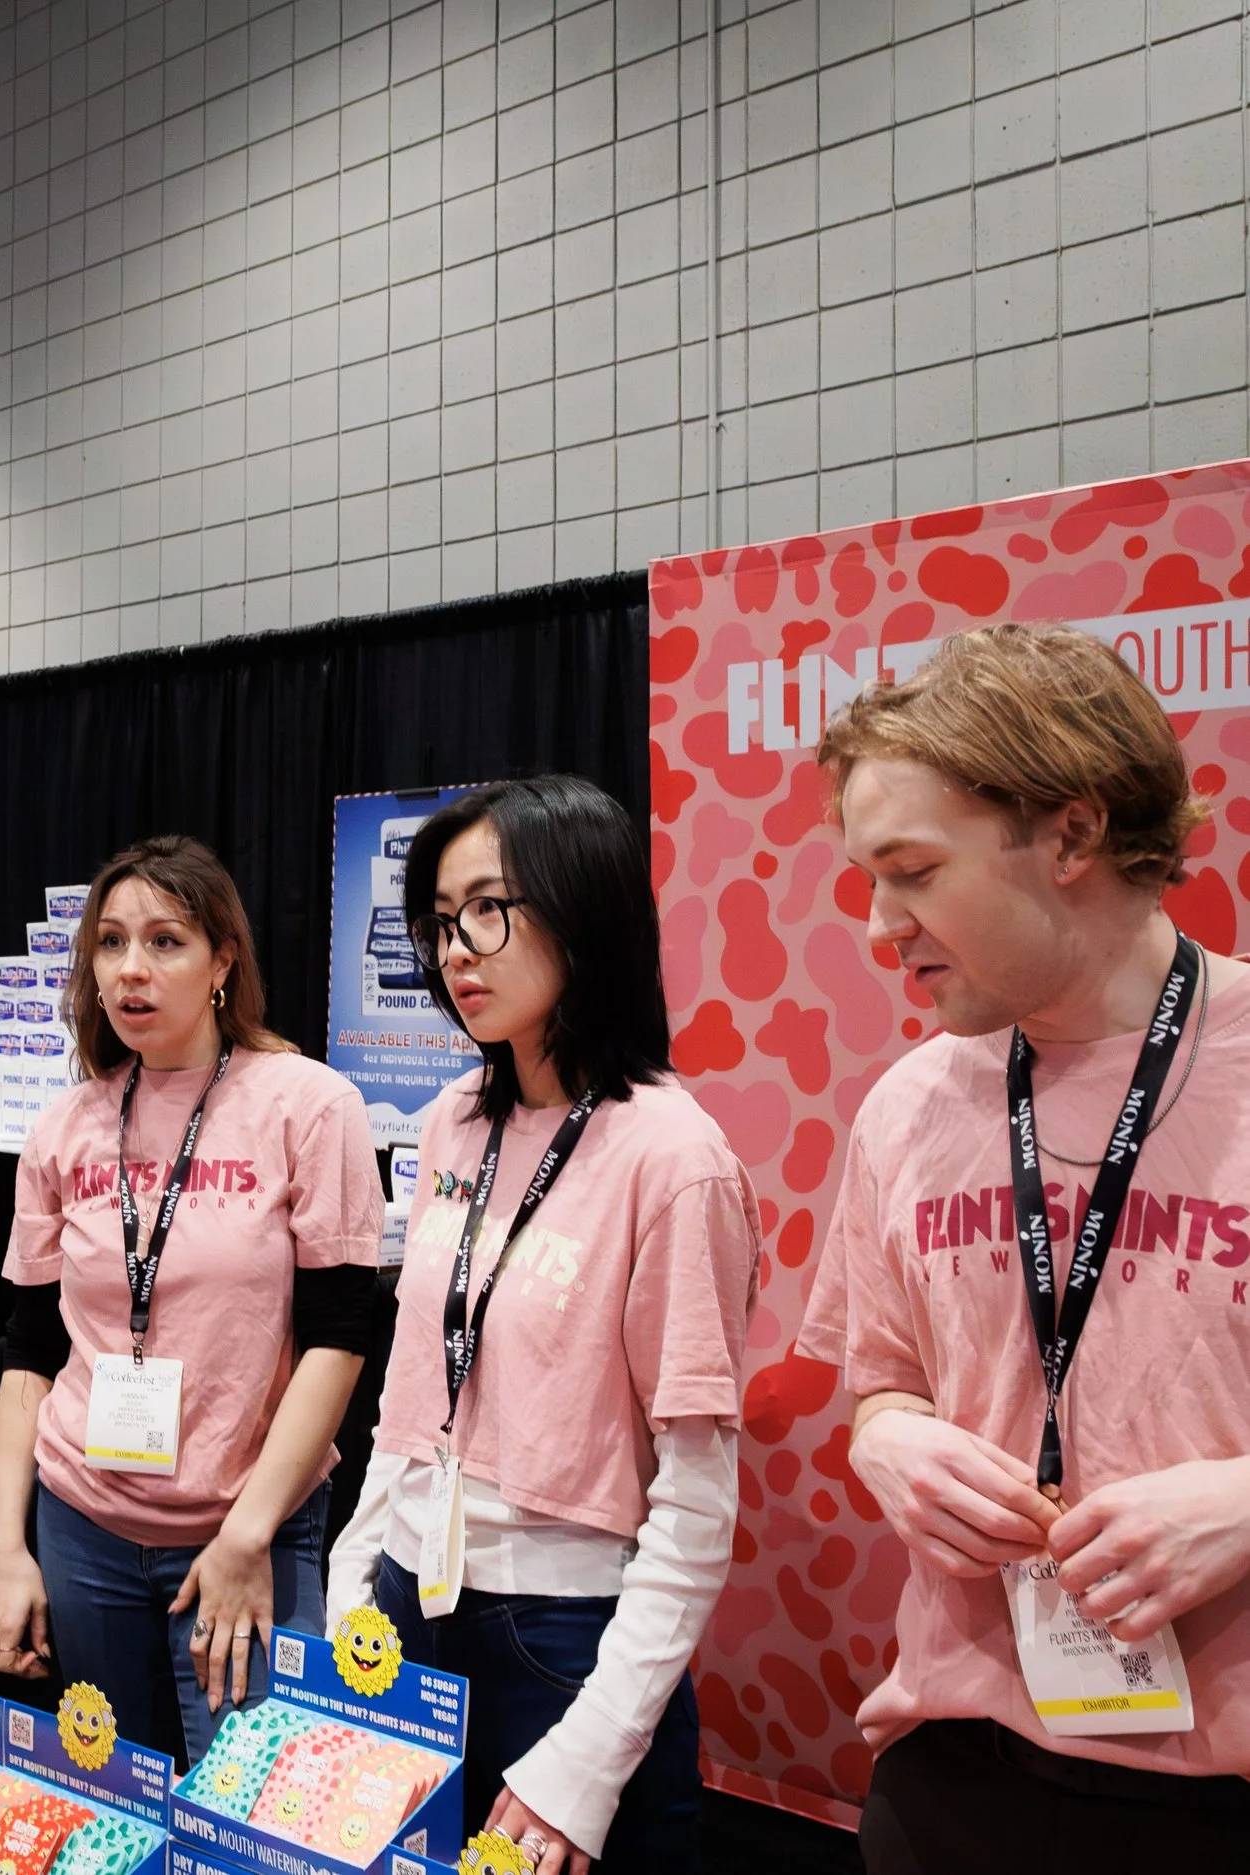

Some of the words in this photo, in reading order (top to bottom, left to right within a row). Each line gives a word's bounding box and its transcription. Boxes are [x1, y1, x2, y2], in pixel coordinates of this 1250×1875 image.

[1113, 618, 1250, 696] OUTH
[377, 995, 417, 1009] POUND
[1148, 972, 1185, 1047] MONIN
[337, 1030, 410, 1047] AVAILABLE
[417, 1032, 447, 1050] THIS
[380, 1054, 428, 1067] INDIVIDUAL
[432, 1057, 462, 1068] CAKES
[395, 1073, 437, 1086] INQUIRIES
[1010, 1097, 1037, 1170] MONIN
[1106, 1088, 1146, 1165] MONIN
[476, 1153, 497, 1206] MONIN
[524, 1149, 559, 1207] MONIN
[161, 1182, 182, 1229] MONIN
[455, 1235, 471, 1293] MONIN
[1020, 1213, 1053, 1294] MONIN
[1069, 1208, 1104, 1290] MONIN
[141, 1255, 159, 1303] MONIN
[421, 1689, 458, 1710] NON-GMO
[433, 1677, 459, 1696] SUGAR
[1082, 1697, 1132, 1712] EXHIBITOR
[274, 1682, 290, 1696] DRY
[291, 1687, 319, 1706] MOUTH
[320, 1695, 328, 1709] IN
[329, 1699, 343, 1713] THE
[344, 1703, 368, 1720] WAY?
[400, 1720, 420, 1737] SAVE
[421, 1726, 436, 1741] THE
[437, 1732, 457, 1748] DAY.
[432, 1707, 458, 1726] VEGAN
[8, 1754, 23, 1768] DRY
[23, 1758, 47, 1779] MOUTH
[48, 1767, 56, 1780] IN
[56, 1771, 68, 1786] THE
[69, 1777, 89, 1794] WAY?
[115, 1794, 132, 1811] SAVE
[133, 1801, 146, 1816] THE
[132, 1766, 164, 1787] NON-GMO
[143, 1755, 165, 1773] SUGAR
[142, 1784, 164, 1802] VEGAN
[173, 1851, 193, 1874] DRY
[174, 1808, 217, 1843] FLINTTS
[219, 1827, 255, 1859] MOUTH
[256, 1842, 309, 1875] WATERING
